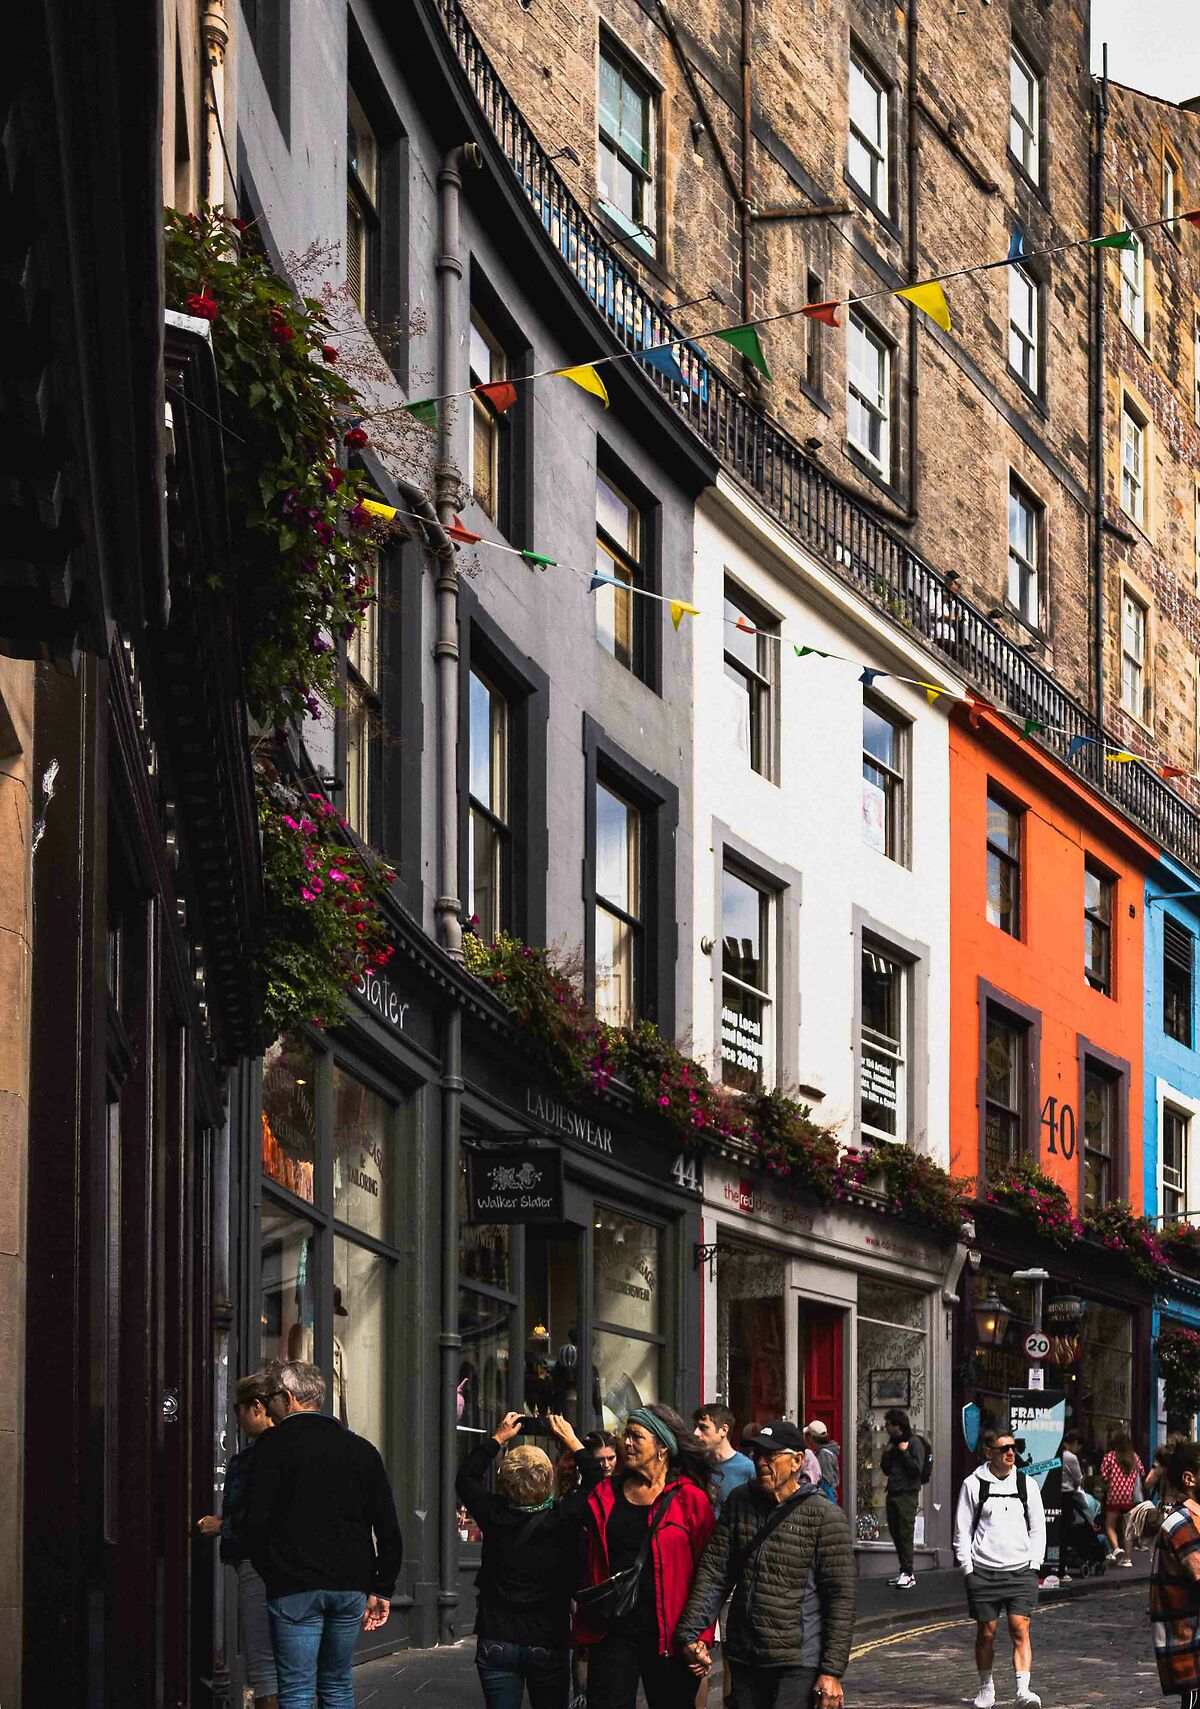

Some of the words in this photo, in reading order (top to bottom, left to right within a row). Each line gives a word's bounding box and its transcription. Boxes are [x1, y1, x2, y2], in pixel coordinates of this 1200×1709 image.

[739, 1013, 760, 1037] Local
[737, 1050, 758, 1073] 2003
[527, 1087, 613, 1153] LADIESWEAR
[1041, 1096, 1075, 1160] 40
[673, 1153, 698, 1190] 44
[477, 1196, 517, 1209] Walker
[520, 1196, 552, 1208] Slater
[724, 1183, 739, 1203] the
[740, 1192, 754, 1208] red
[755, 1195, 778, 1215] door
[782, 1207, 814, 1231] gallery
[1027, 1338, 1049, 1353] 20
[1011, 1406, 1053, 1419] FRANK
